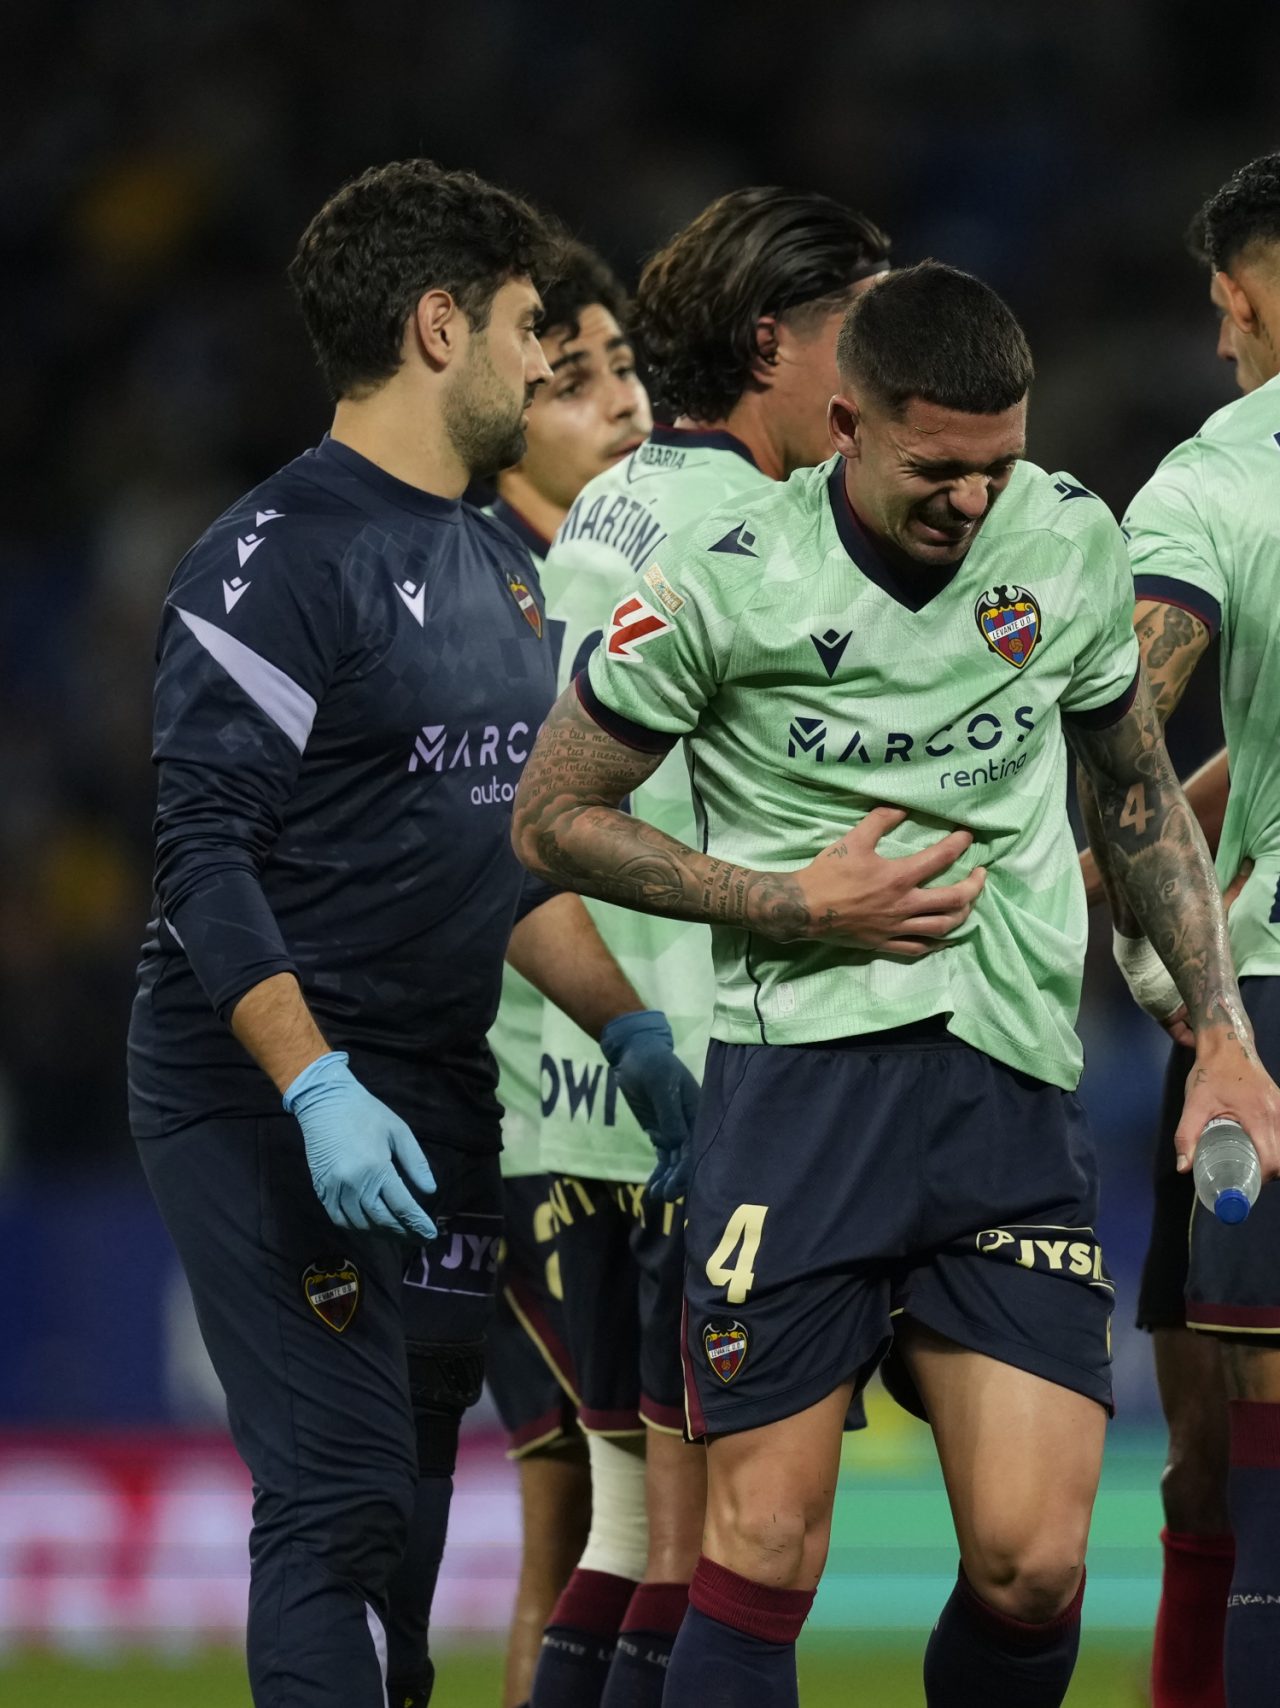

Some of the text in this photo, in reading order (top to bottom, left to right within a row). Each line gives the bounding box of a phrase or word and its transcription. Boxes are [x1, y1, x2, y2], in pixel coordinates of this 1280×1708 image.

[992, 622, 1019, 640] LEVANTE
[408, 721, 543, 772] MARC
[788, 705, 1036, 763] MARCOS
[471, 776, 519, 805] auto
[940, 753, 1027, 789] renting
[705, 1203, 769, 1303] 4
